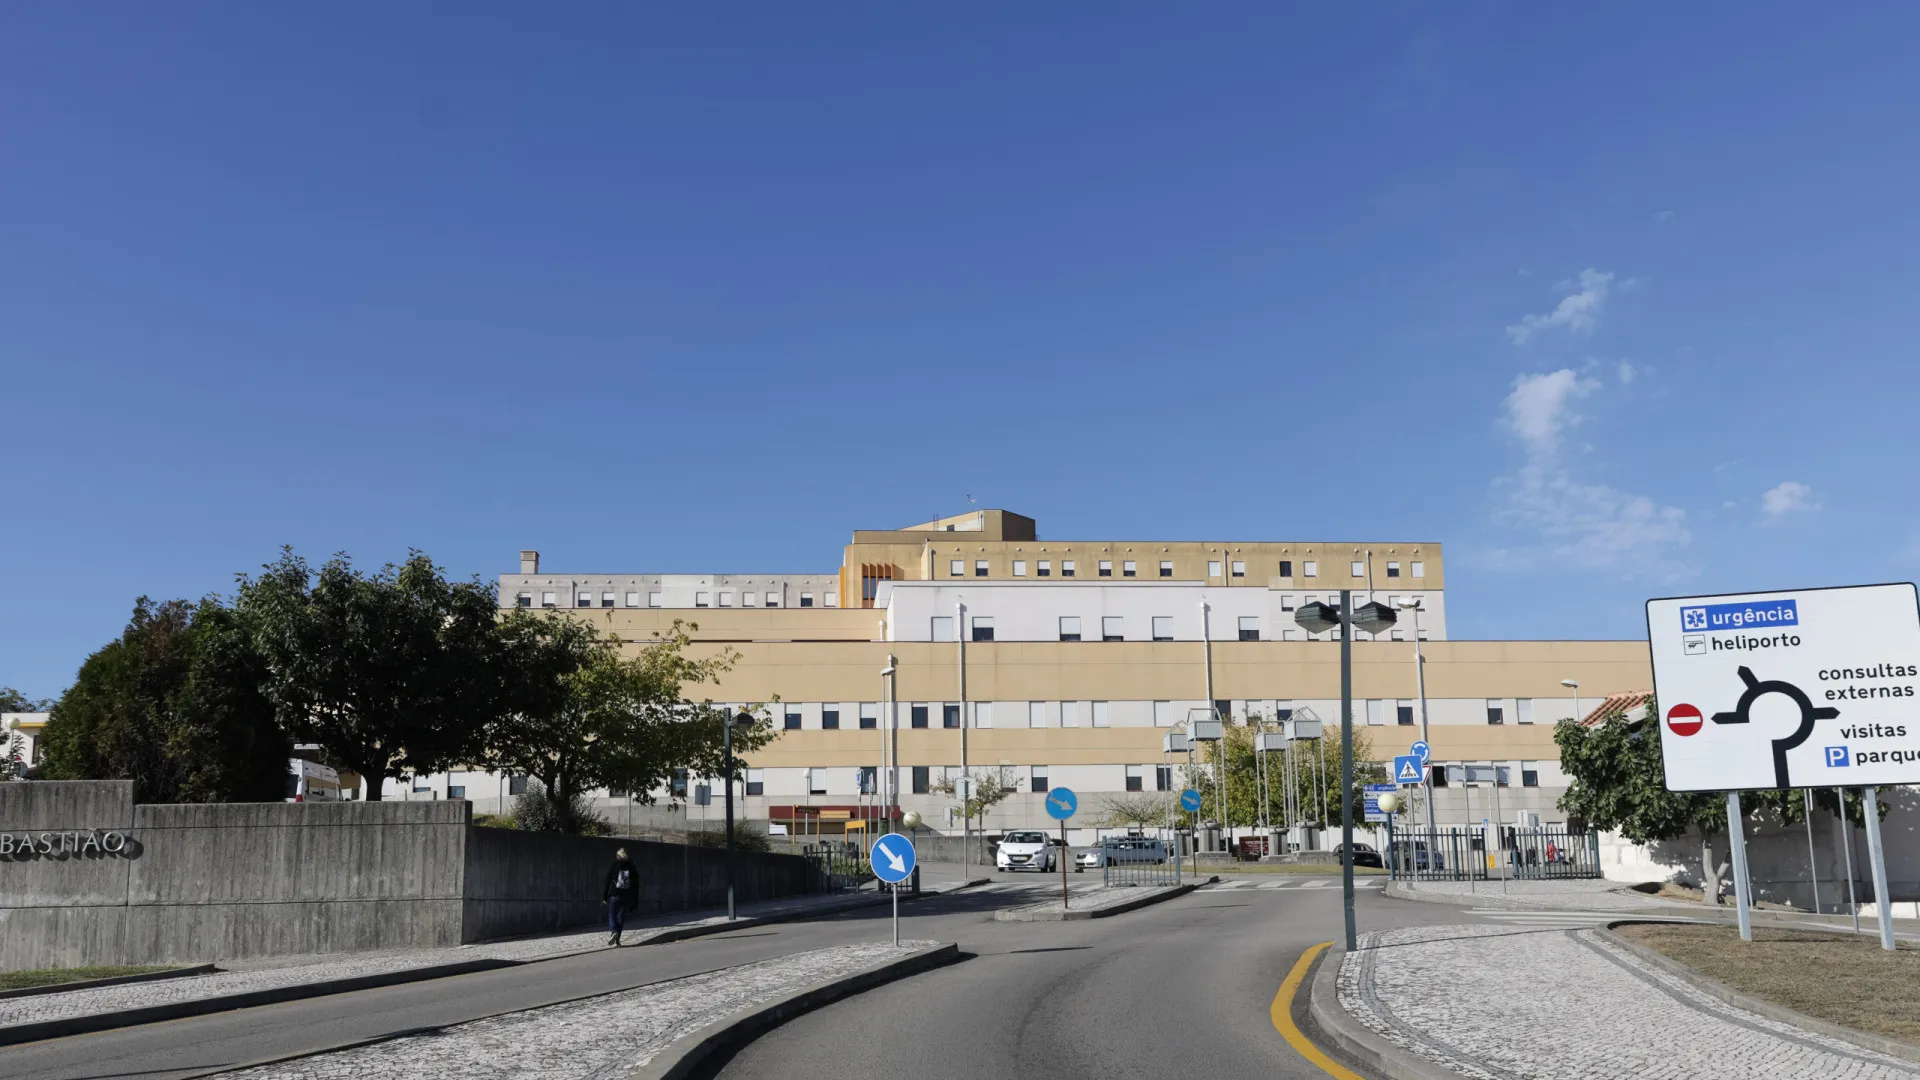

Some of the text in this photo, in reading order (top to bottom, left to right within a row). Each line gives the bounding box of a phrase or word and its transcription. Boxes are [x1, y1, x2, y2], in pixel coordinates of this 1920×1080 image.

[1712, 605, 1795, 627] urgência
[1712, 633, 1801, 651] heliporto
[1818, 663, 1918, 681] consultas
[1825, 685, 1914, 700] externas
[1840, 723, 1907, 739] visitas
